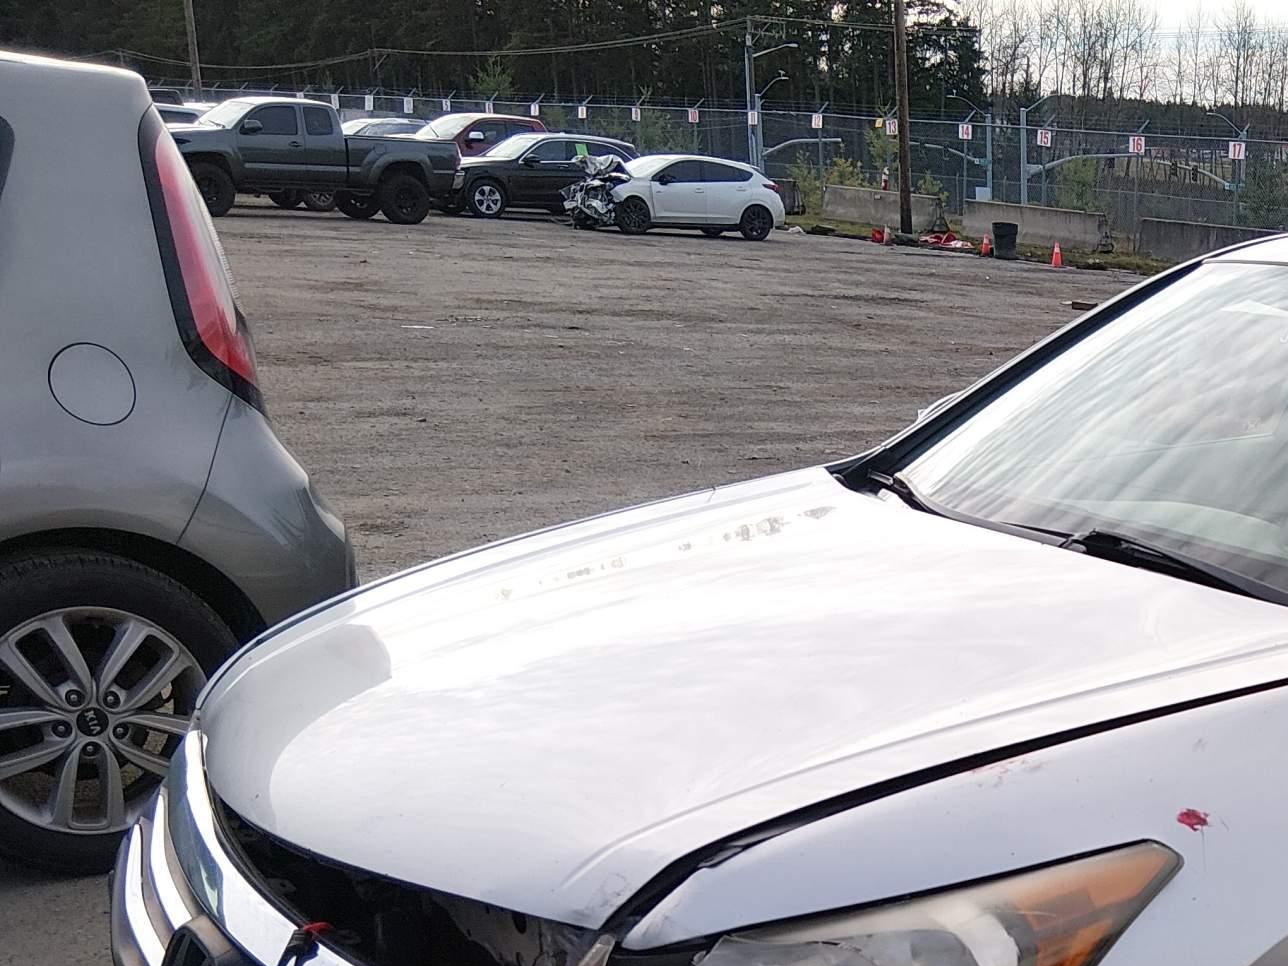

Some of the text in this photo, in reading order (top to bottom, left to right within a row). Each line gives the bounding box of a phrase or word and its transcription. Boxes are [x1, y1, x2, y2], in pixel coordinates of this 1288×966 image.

[814, 115, 821, 127] 12
[888, 120, 897, 134] 13
[961, 125, 970, 138] 14
[1040, 131, 1049, 145] 15
[1132, 137, 1142, 151] 16
[1233, 143, 1243, 158] 17
[84, 710, 101, 734] KIA
